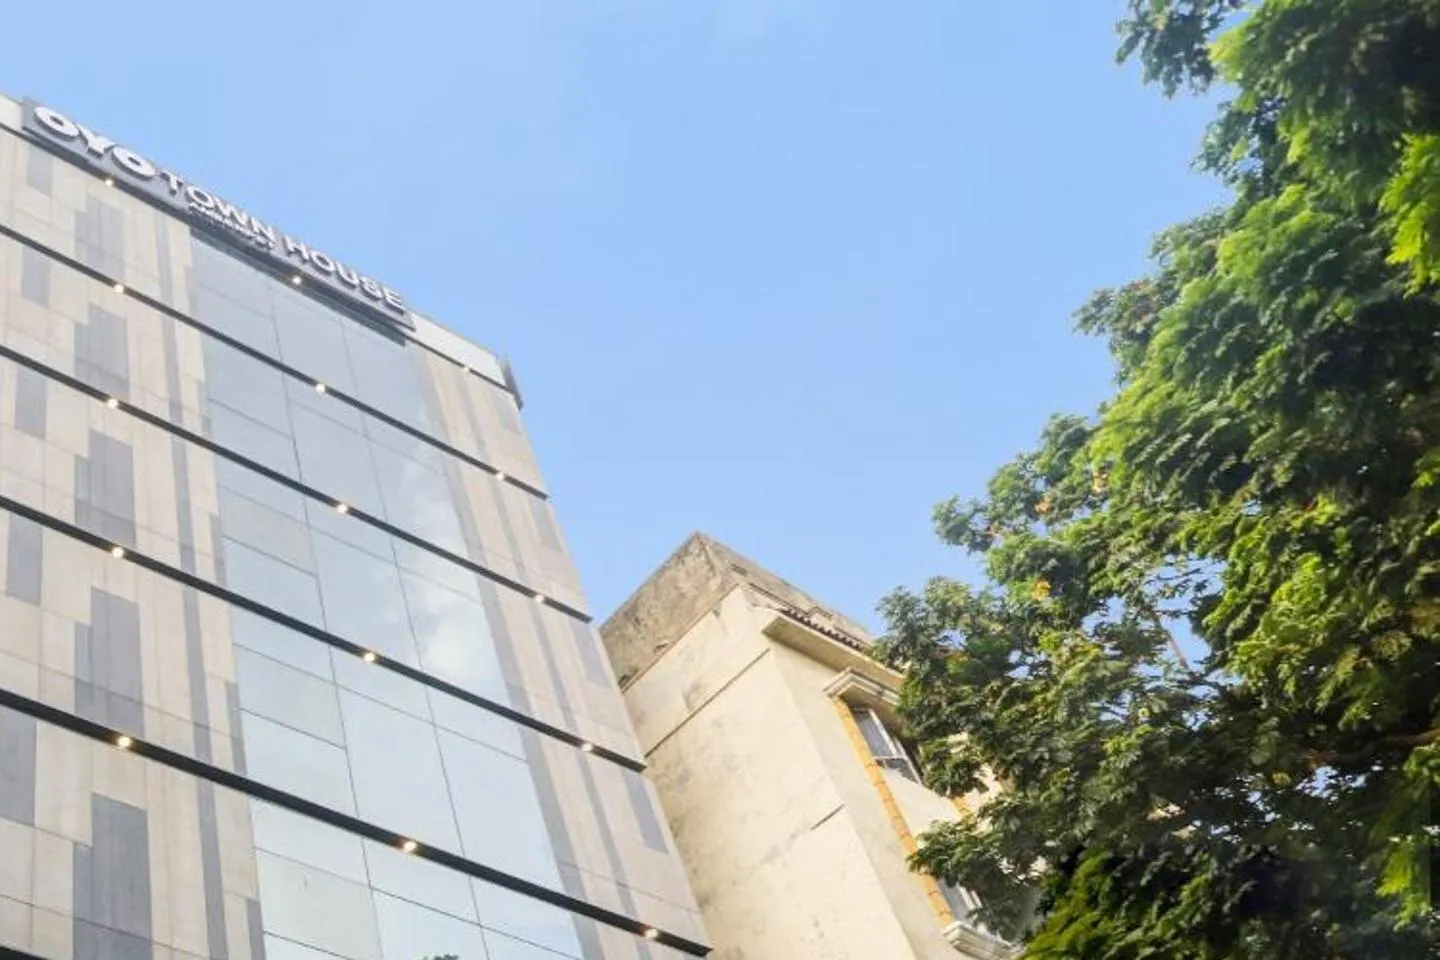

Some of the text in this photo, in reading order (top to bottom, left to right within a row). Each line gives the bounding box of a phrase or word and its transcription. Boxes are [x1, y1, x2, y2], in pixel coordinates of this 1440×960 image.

[33, 105, 156, 178] OYO
[159, 169, 276, 243] TOWN
[283, 234, 405, 312] HOUSE
